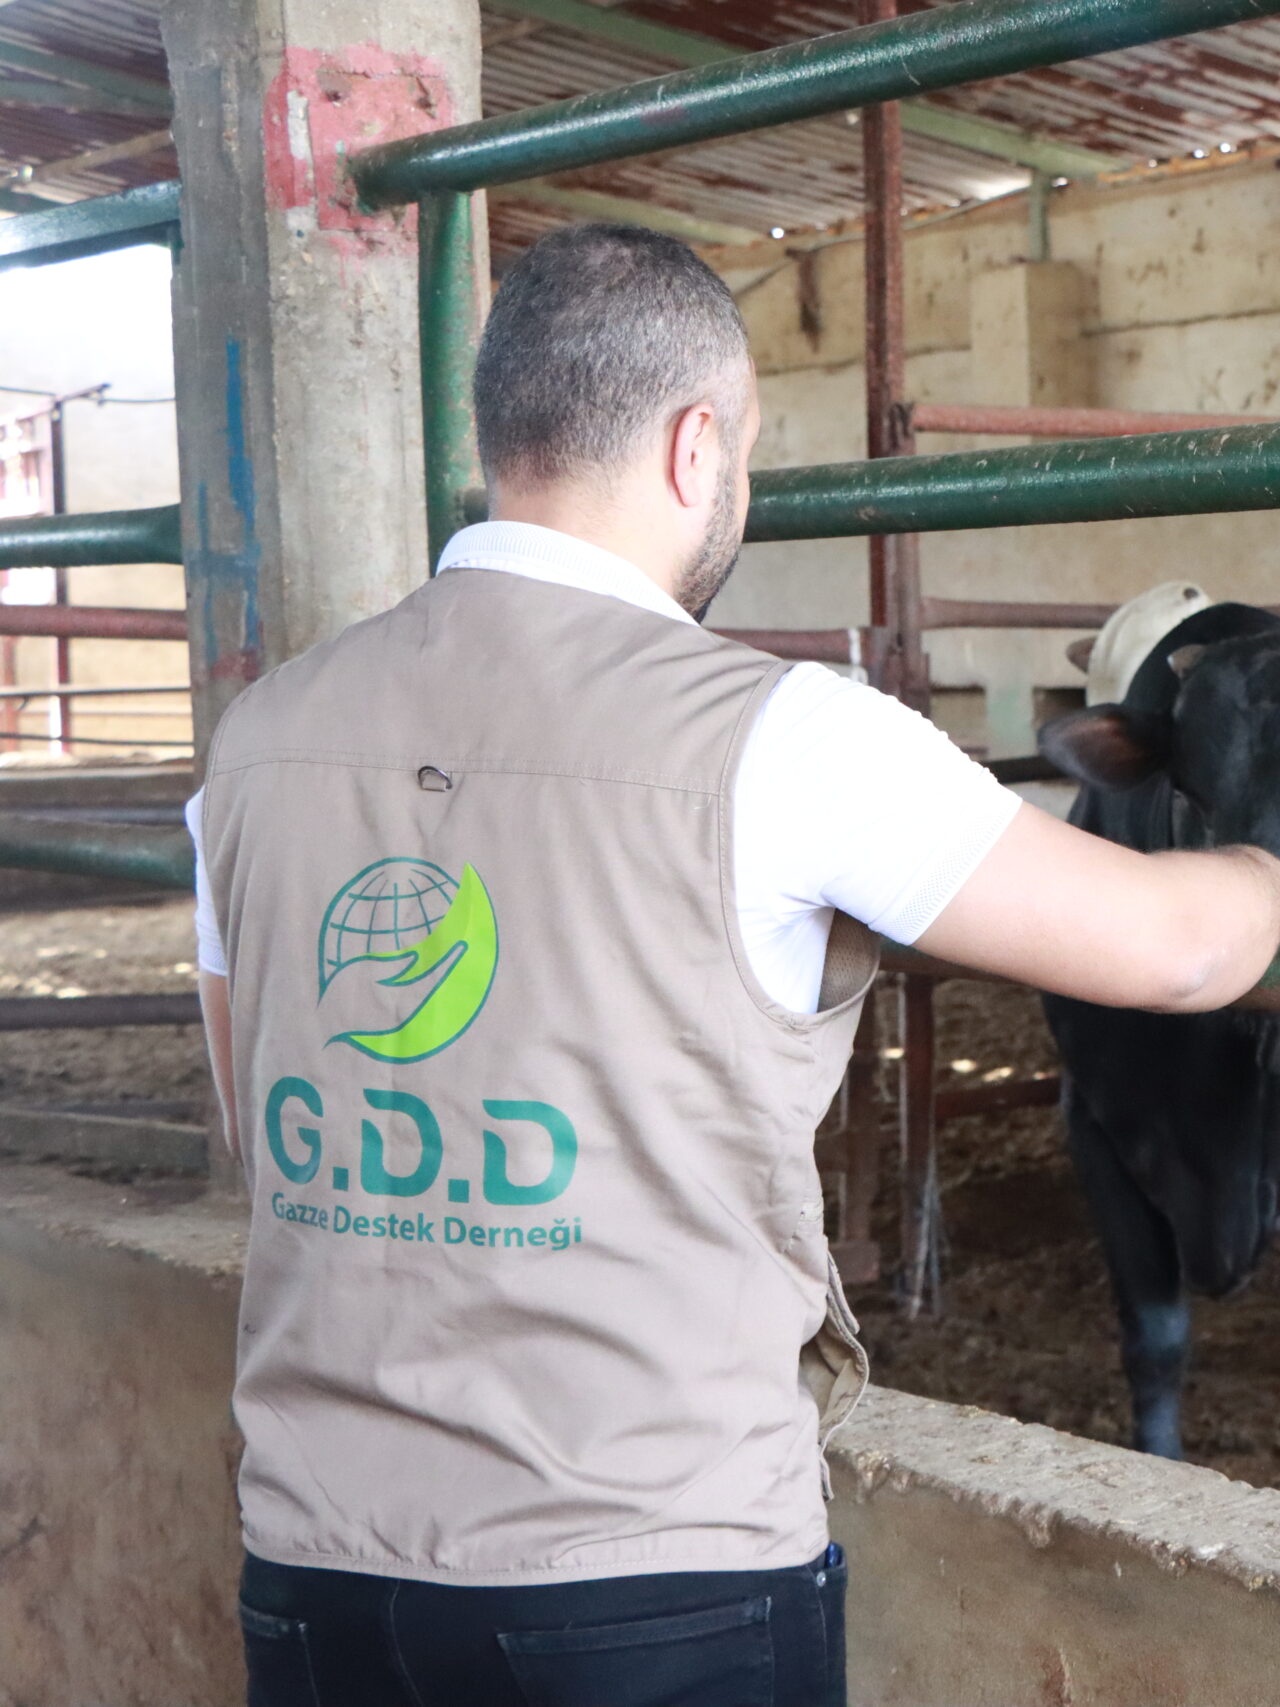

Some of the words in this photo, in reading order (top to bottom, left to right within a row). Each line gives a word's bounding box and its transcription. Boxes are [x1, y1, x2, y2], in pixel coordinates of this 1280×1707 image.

[265, 1076, 578, 1206] G.D.D
[271, 1192, 329, 1230] Gazze
[332, 1206, 435, 1243] Destek
[443, 1216, 583, 1250] Derneği
